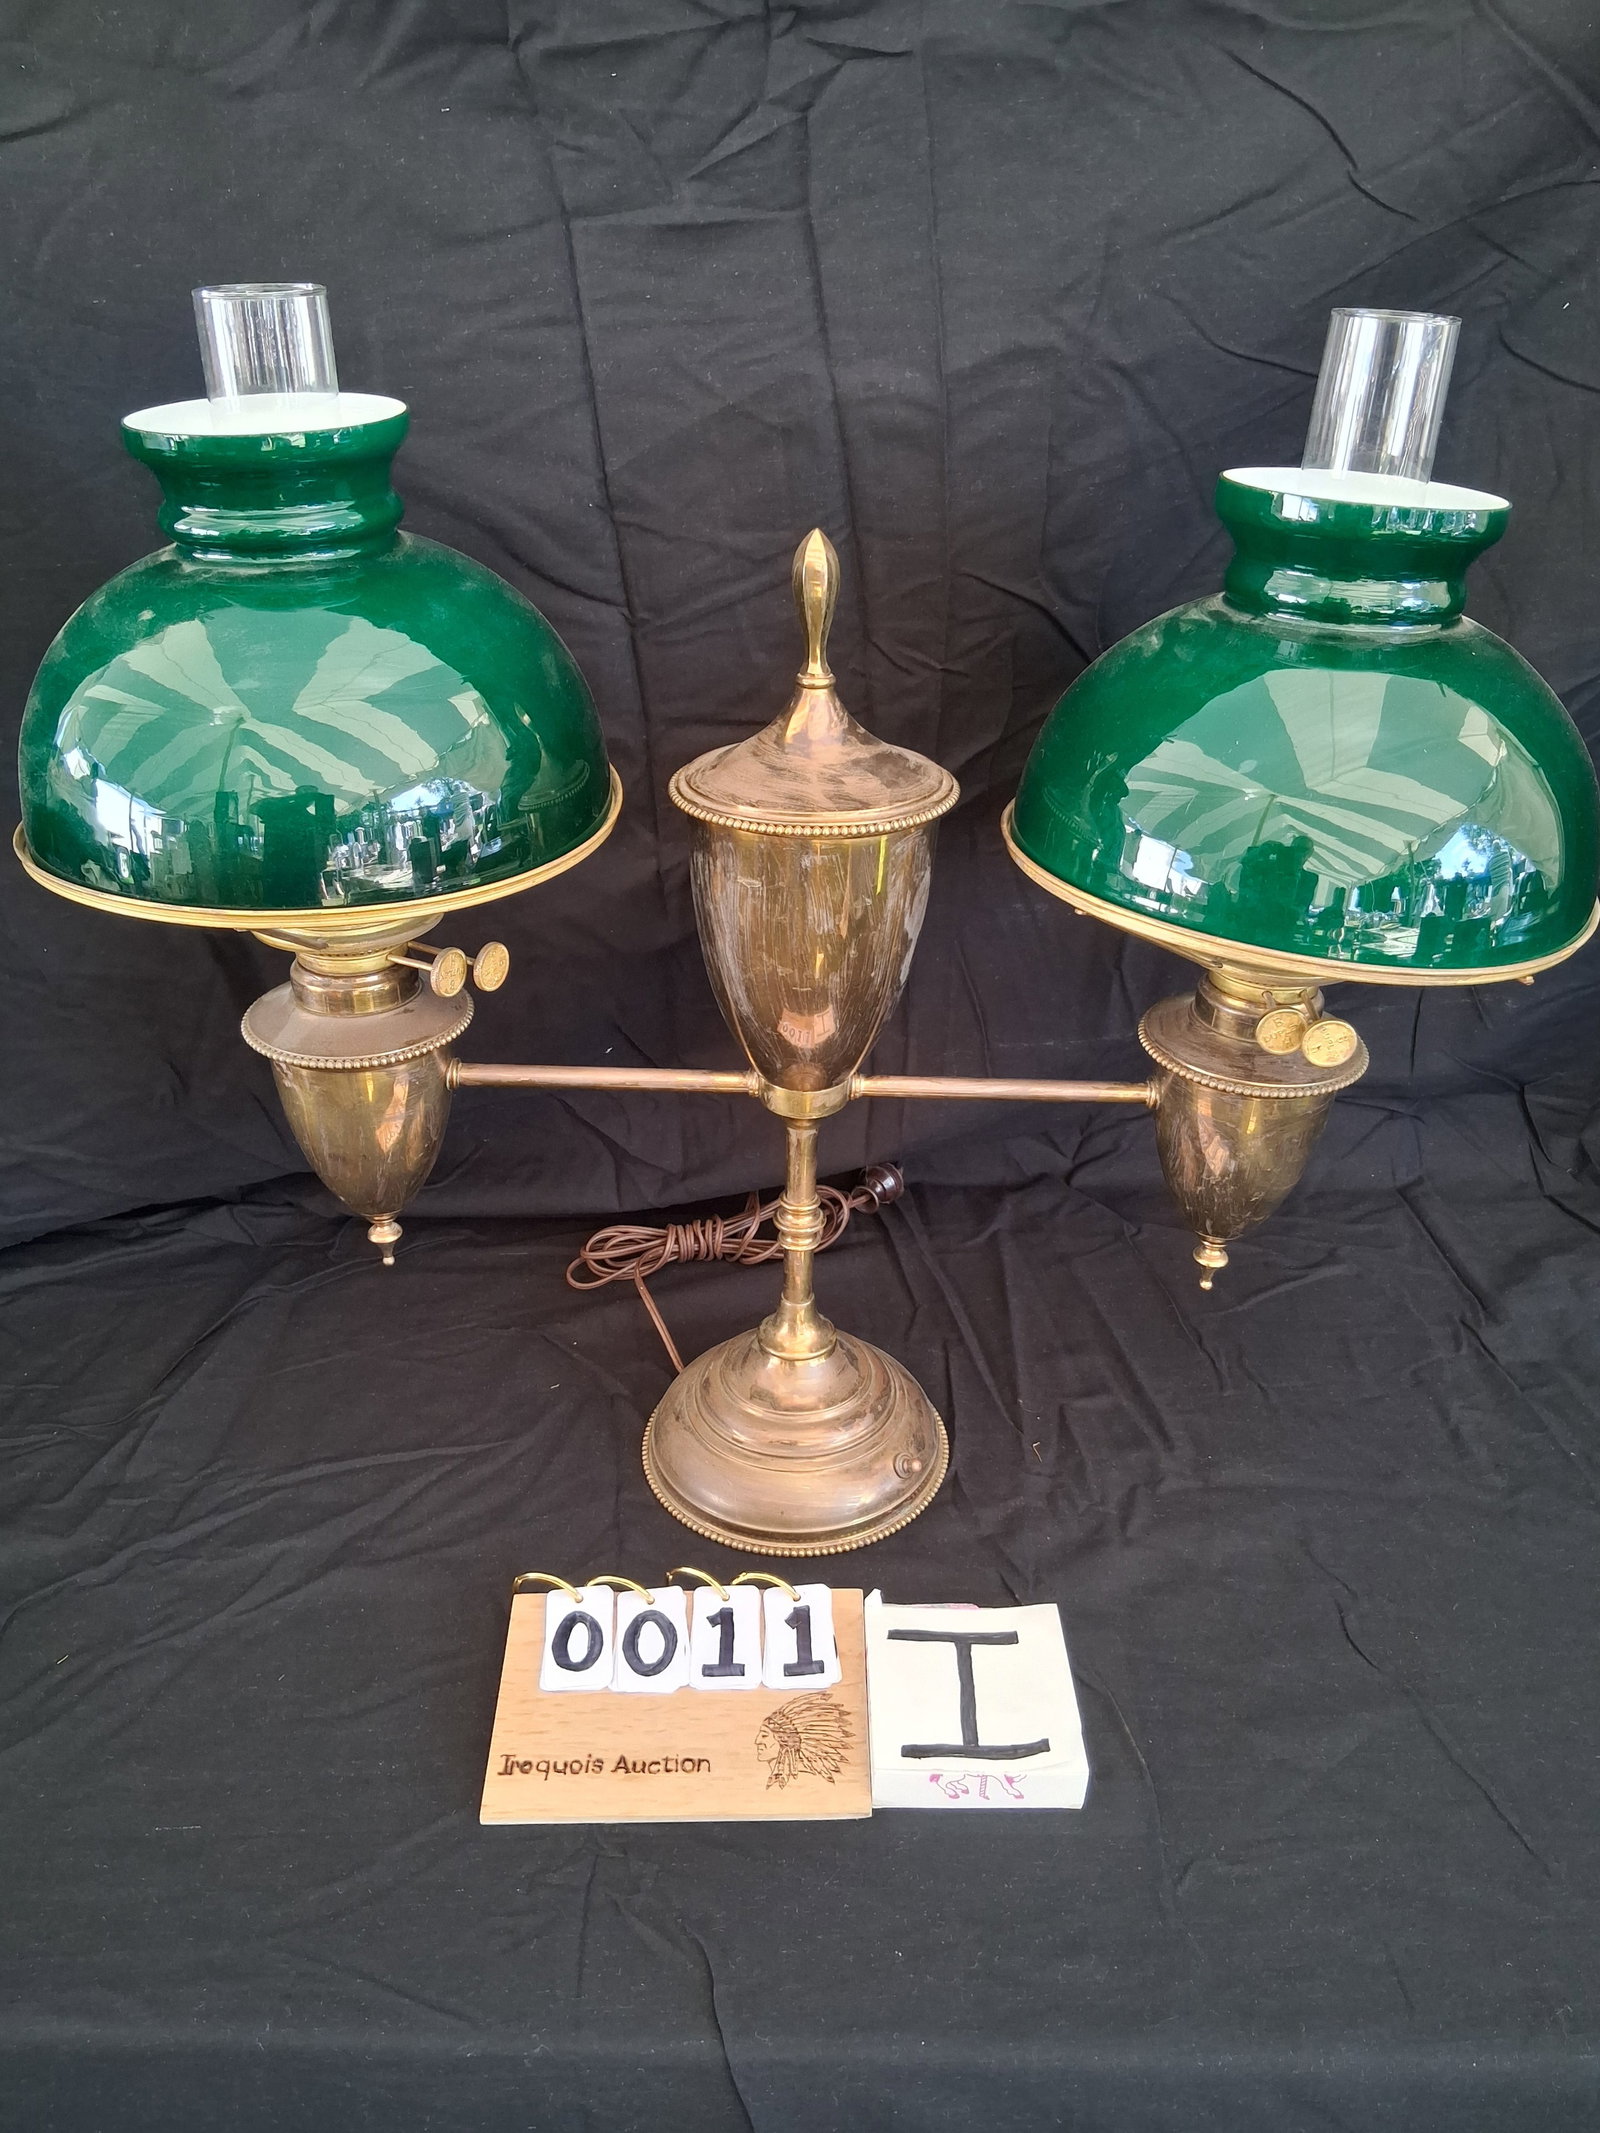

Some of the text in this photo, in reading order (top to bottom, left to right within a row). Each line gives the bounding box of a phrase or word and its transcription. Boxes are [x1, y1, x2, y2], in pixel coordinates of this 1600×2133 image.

[551, 1604, 825, 1678] 0011
[887, 1629, 1051, 1761] I
[610, 1753, 711, 1775] Auction
